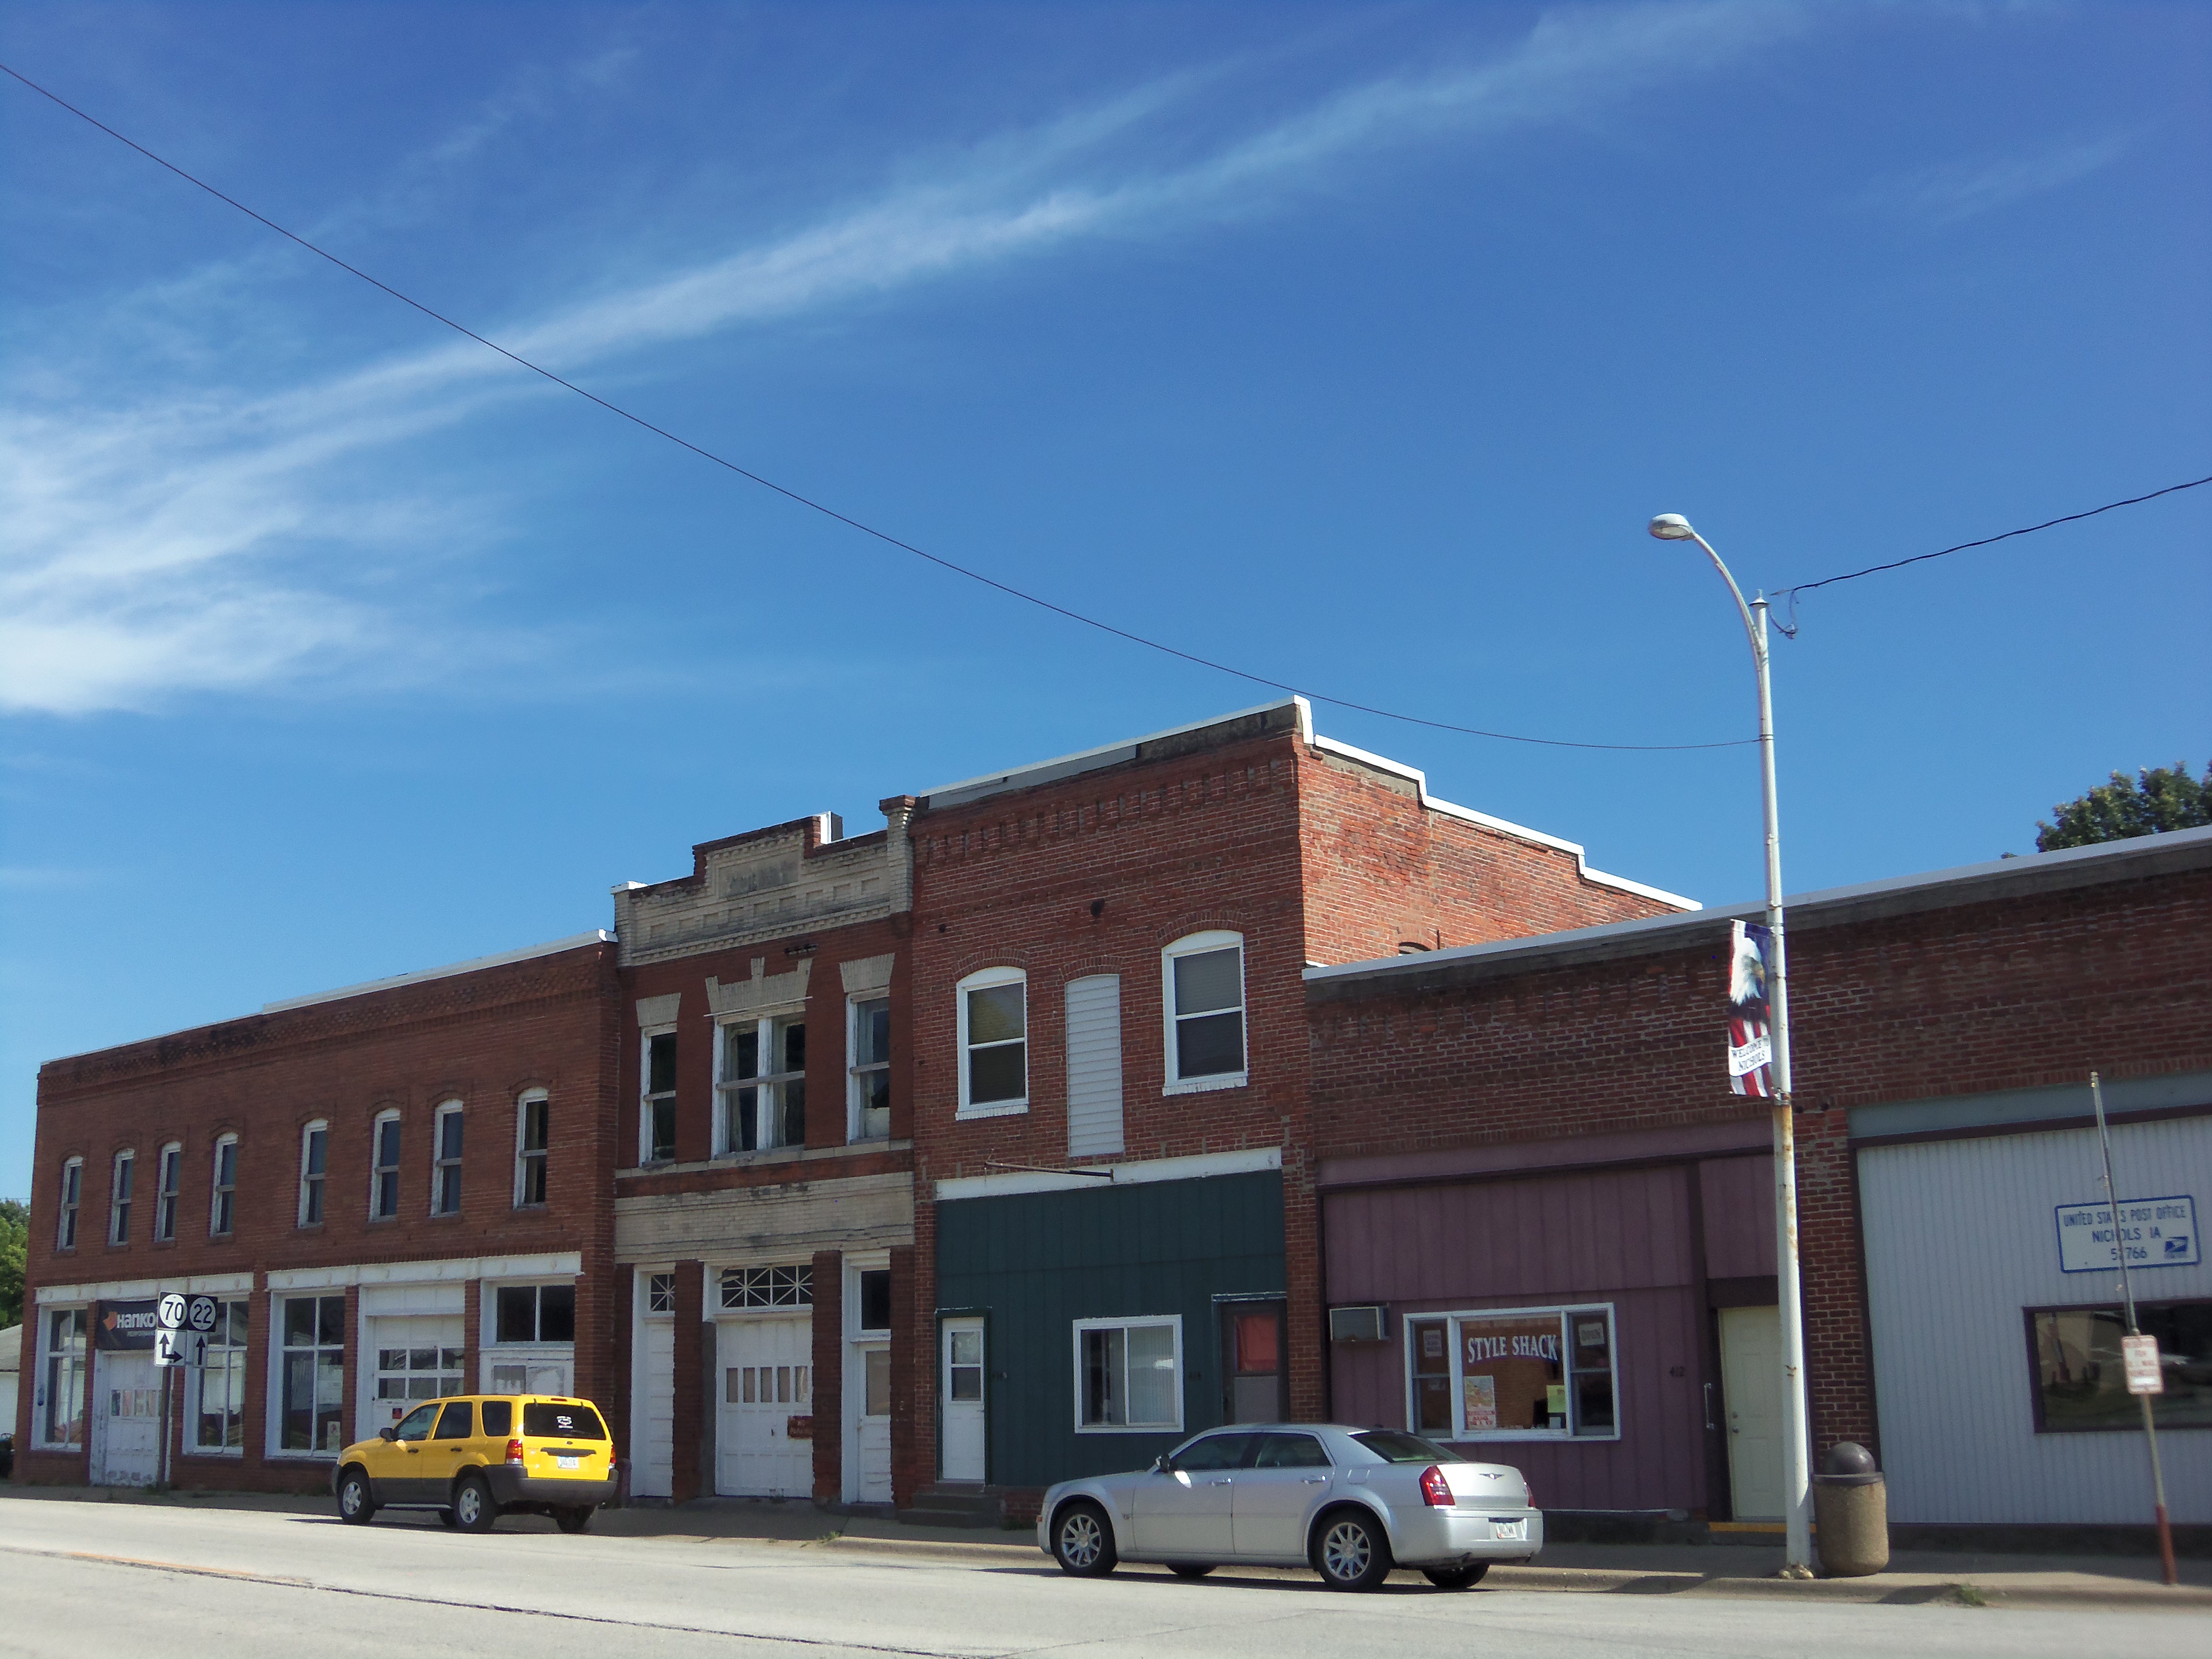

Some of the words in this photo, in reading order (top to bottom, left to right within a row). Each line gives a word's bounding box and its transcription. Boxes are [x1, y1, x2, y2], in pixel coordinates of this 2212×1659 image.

[1731, 1039, 1762, 1058] WELCOME
[1738, 1050, 1765, 1071] NICHOLS
[2063, 1213, 2092, 1226] UNITED
[2097, 1211, 2127, 1224] STAS
[2130, 1208, 2151, 1221] POST
[2156, 1205, 2186, 1220] OFFICE
[2150, 1226, 2161, 1238] IA
[165, 1301, 184, 1321] 70
[193, 1303, 213, 1323] 22
[1468, 1336, 1507, 1363] STYLE
[1512, 1334, 1558, 1361] SHACK
